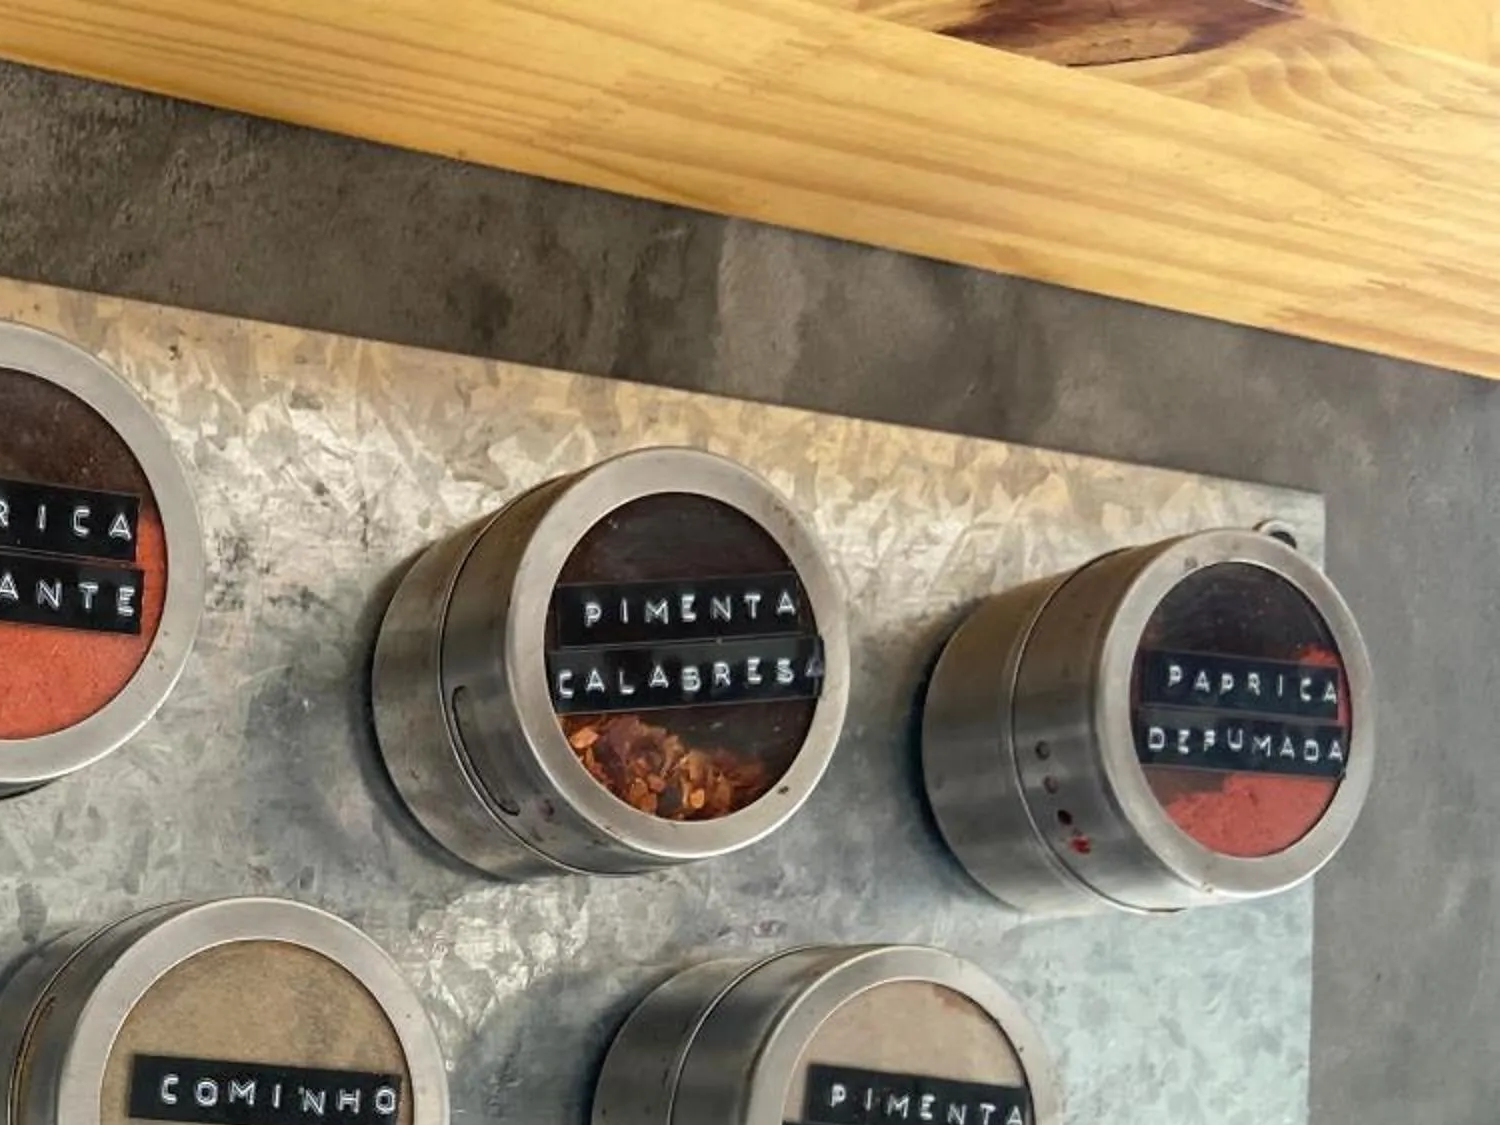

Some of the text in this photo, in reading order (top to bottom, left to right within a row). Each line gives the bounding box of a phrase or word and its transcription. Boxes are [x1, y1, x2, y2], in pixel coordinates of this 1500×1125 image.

[583, 590, 797, 628] PIMENTA
[1167, 664, 1338, 705] PAPRICA
[1147, 726, 1343, 763] DEFUMADA
[160, 1073, 397, 1116] COMINHO
